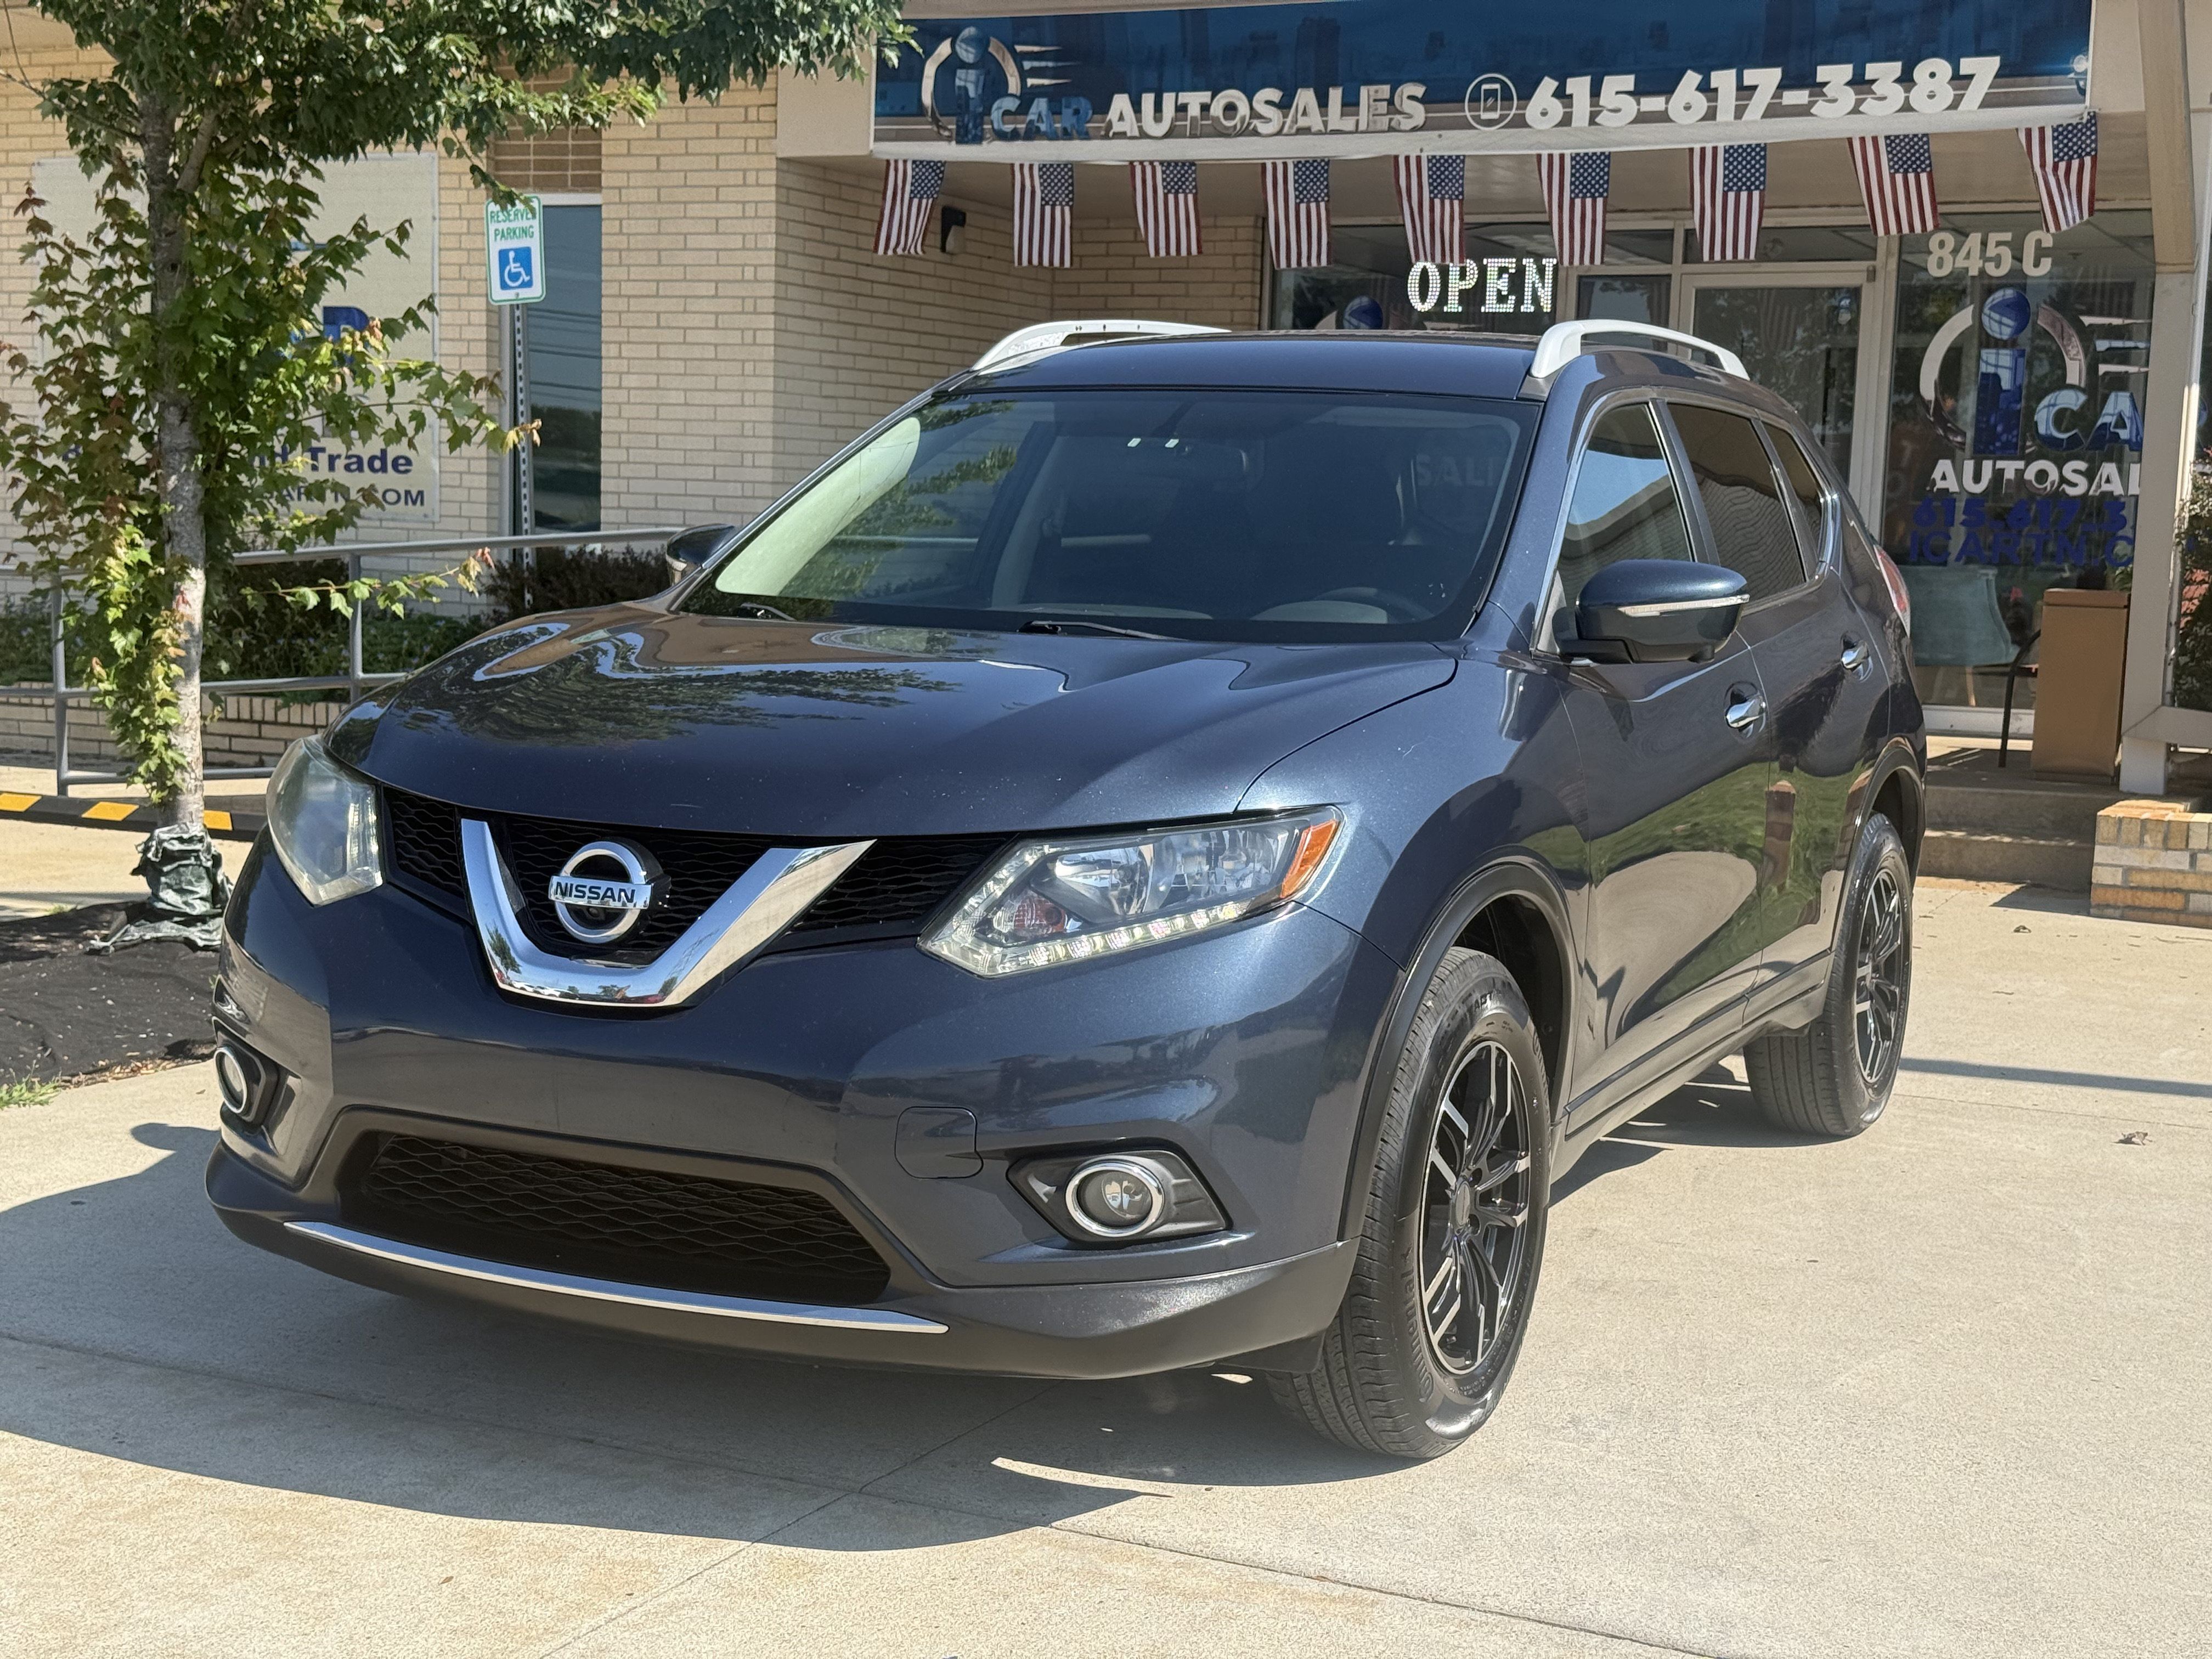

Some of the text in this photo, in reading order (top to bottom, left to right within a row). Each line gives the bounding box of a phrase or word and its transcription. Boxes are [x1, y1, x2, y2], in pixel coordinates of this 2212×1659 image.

[991, 96, 1093, 142] CAR
[1101, 82, 1426, 137] AUTOSALES
[1525, 56, 2001, 130] 615-617-3387
[490, 207, 537, 223] RESERVE
[494, 225, 534, 241] PARKING
[1927, 230, 2053, 277] 845 C
[1407, 258, 1557, 313] OPEN
[308, 447, 413, 475] Trade
[555, 881, 636, 904] NISSAN
